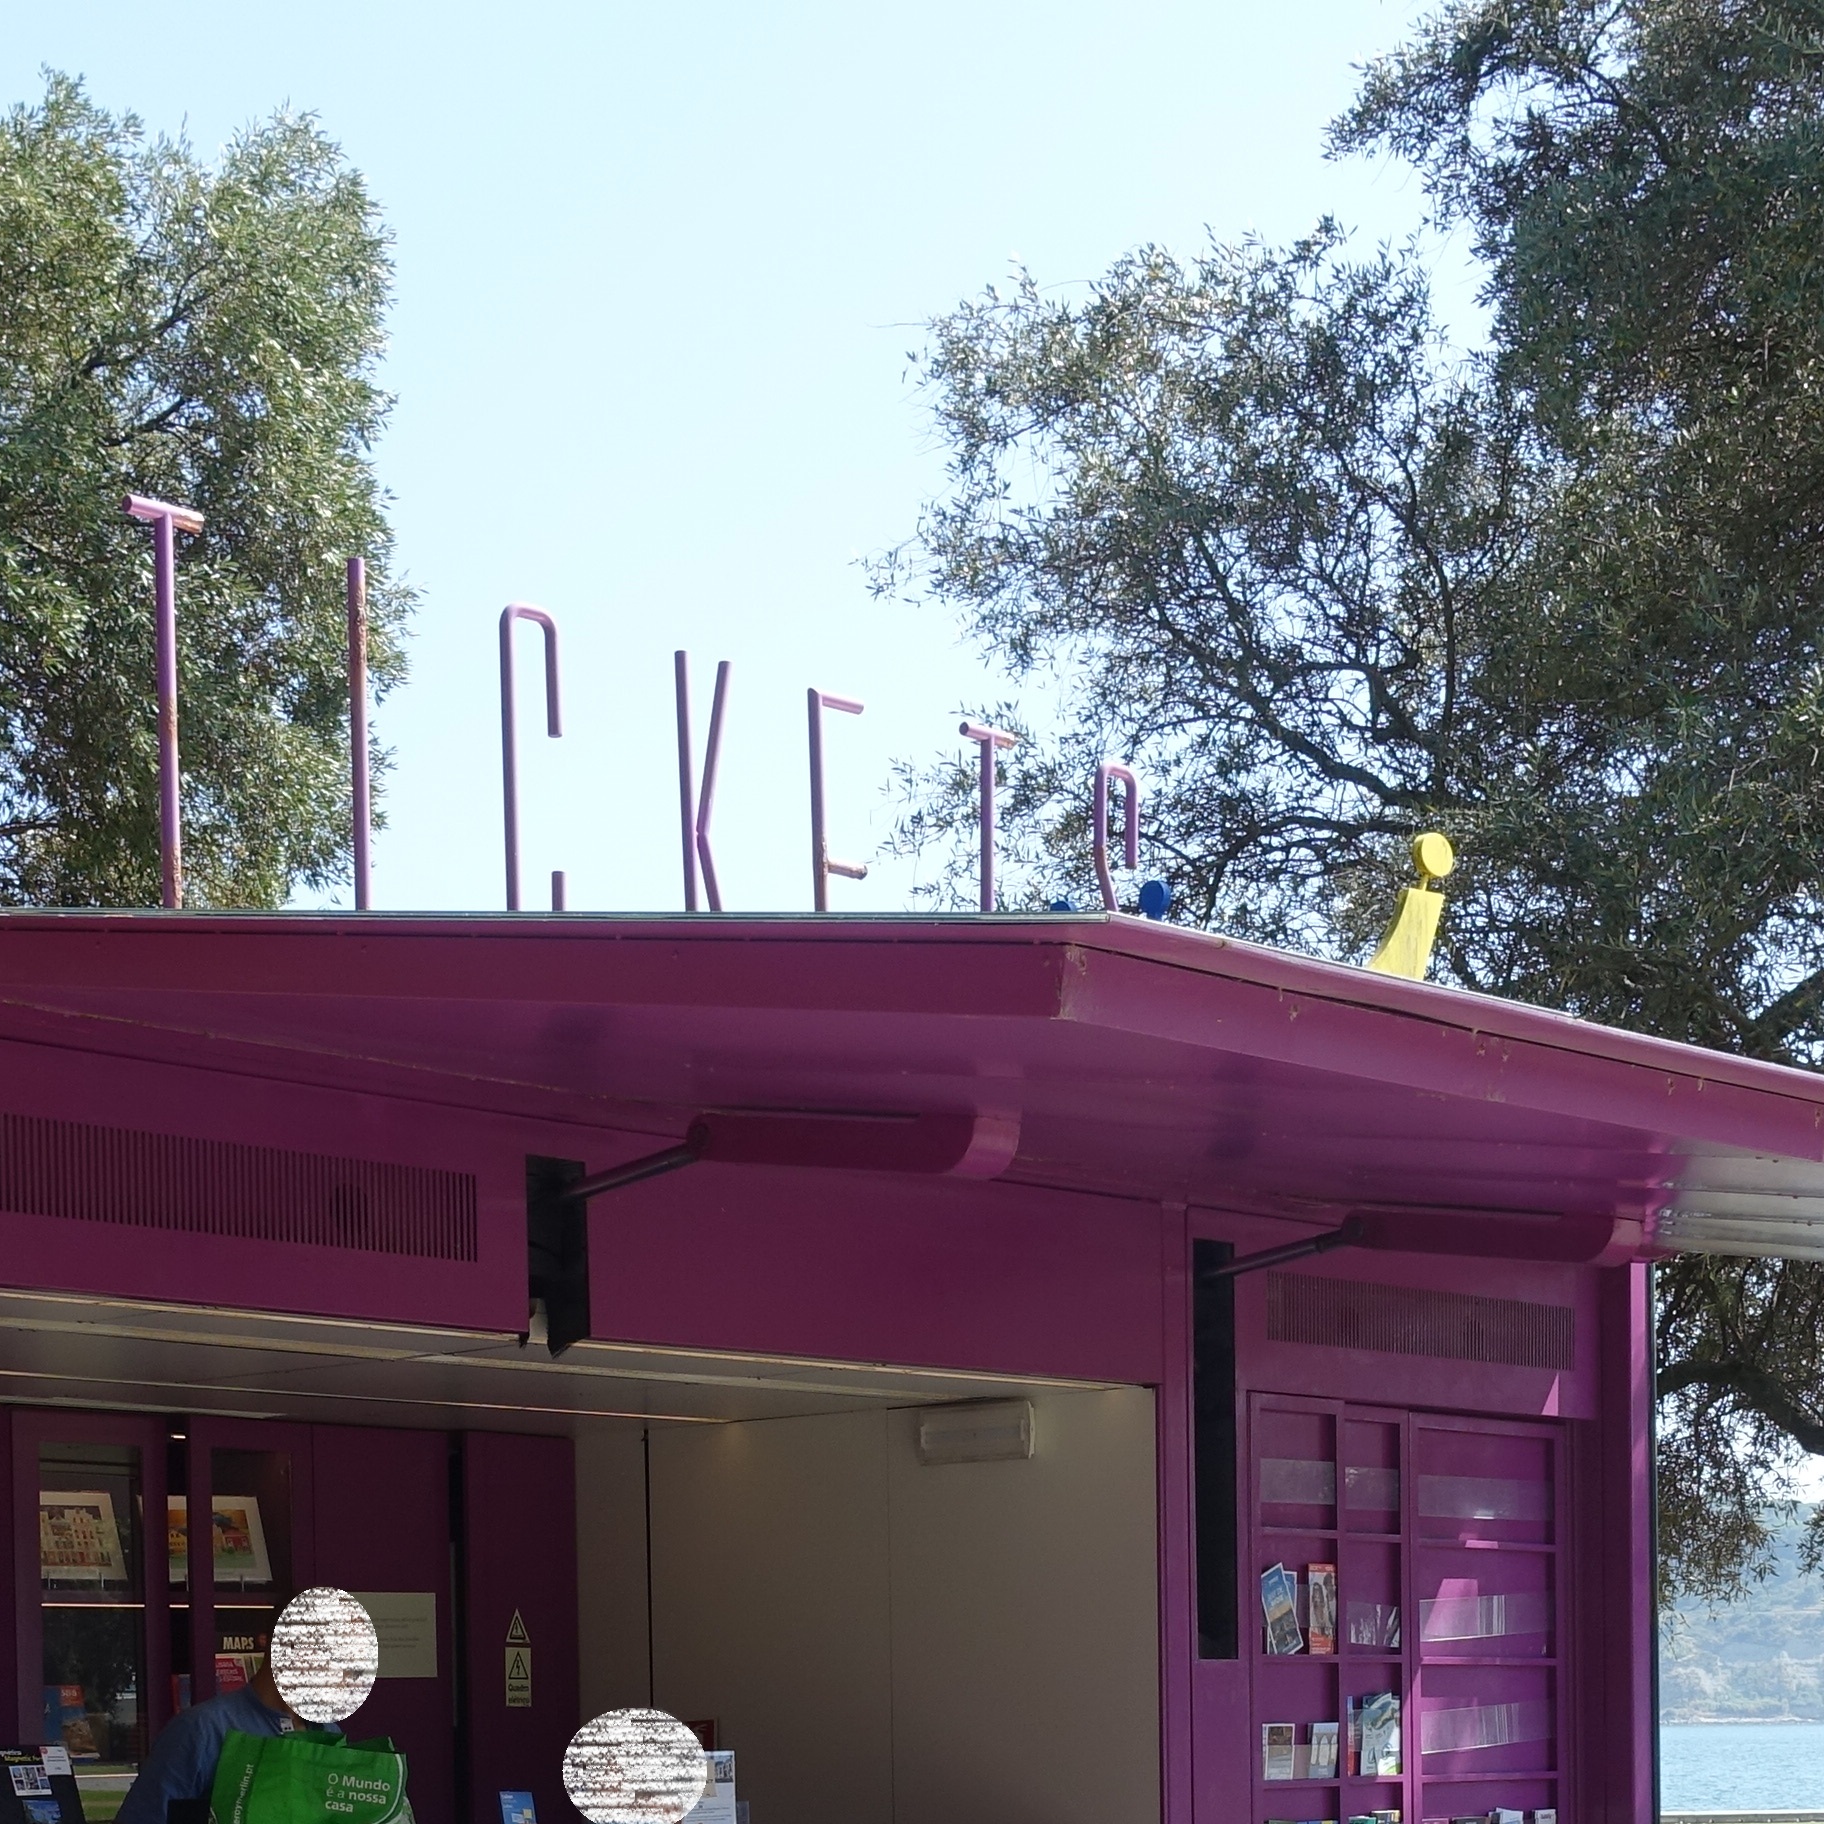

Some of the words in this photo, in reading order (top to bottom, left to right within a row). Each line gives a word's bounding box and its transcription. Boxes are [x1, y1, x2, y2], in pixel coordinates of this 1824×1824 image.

[222, 1636, 255, 1650] MAPS
[327, 1772, 339, 1786] O
[342, 1775, 391, 1792] Mundo
[325, 1786, 335, 1798] é
[336, 1789, 346, 1799] a
[348, 1791, 387, 1805] nossa
[325, 1801, 354, 1813] casa
